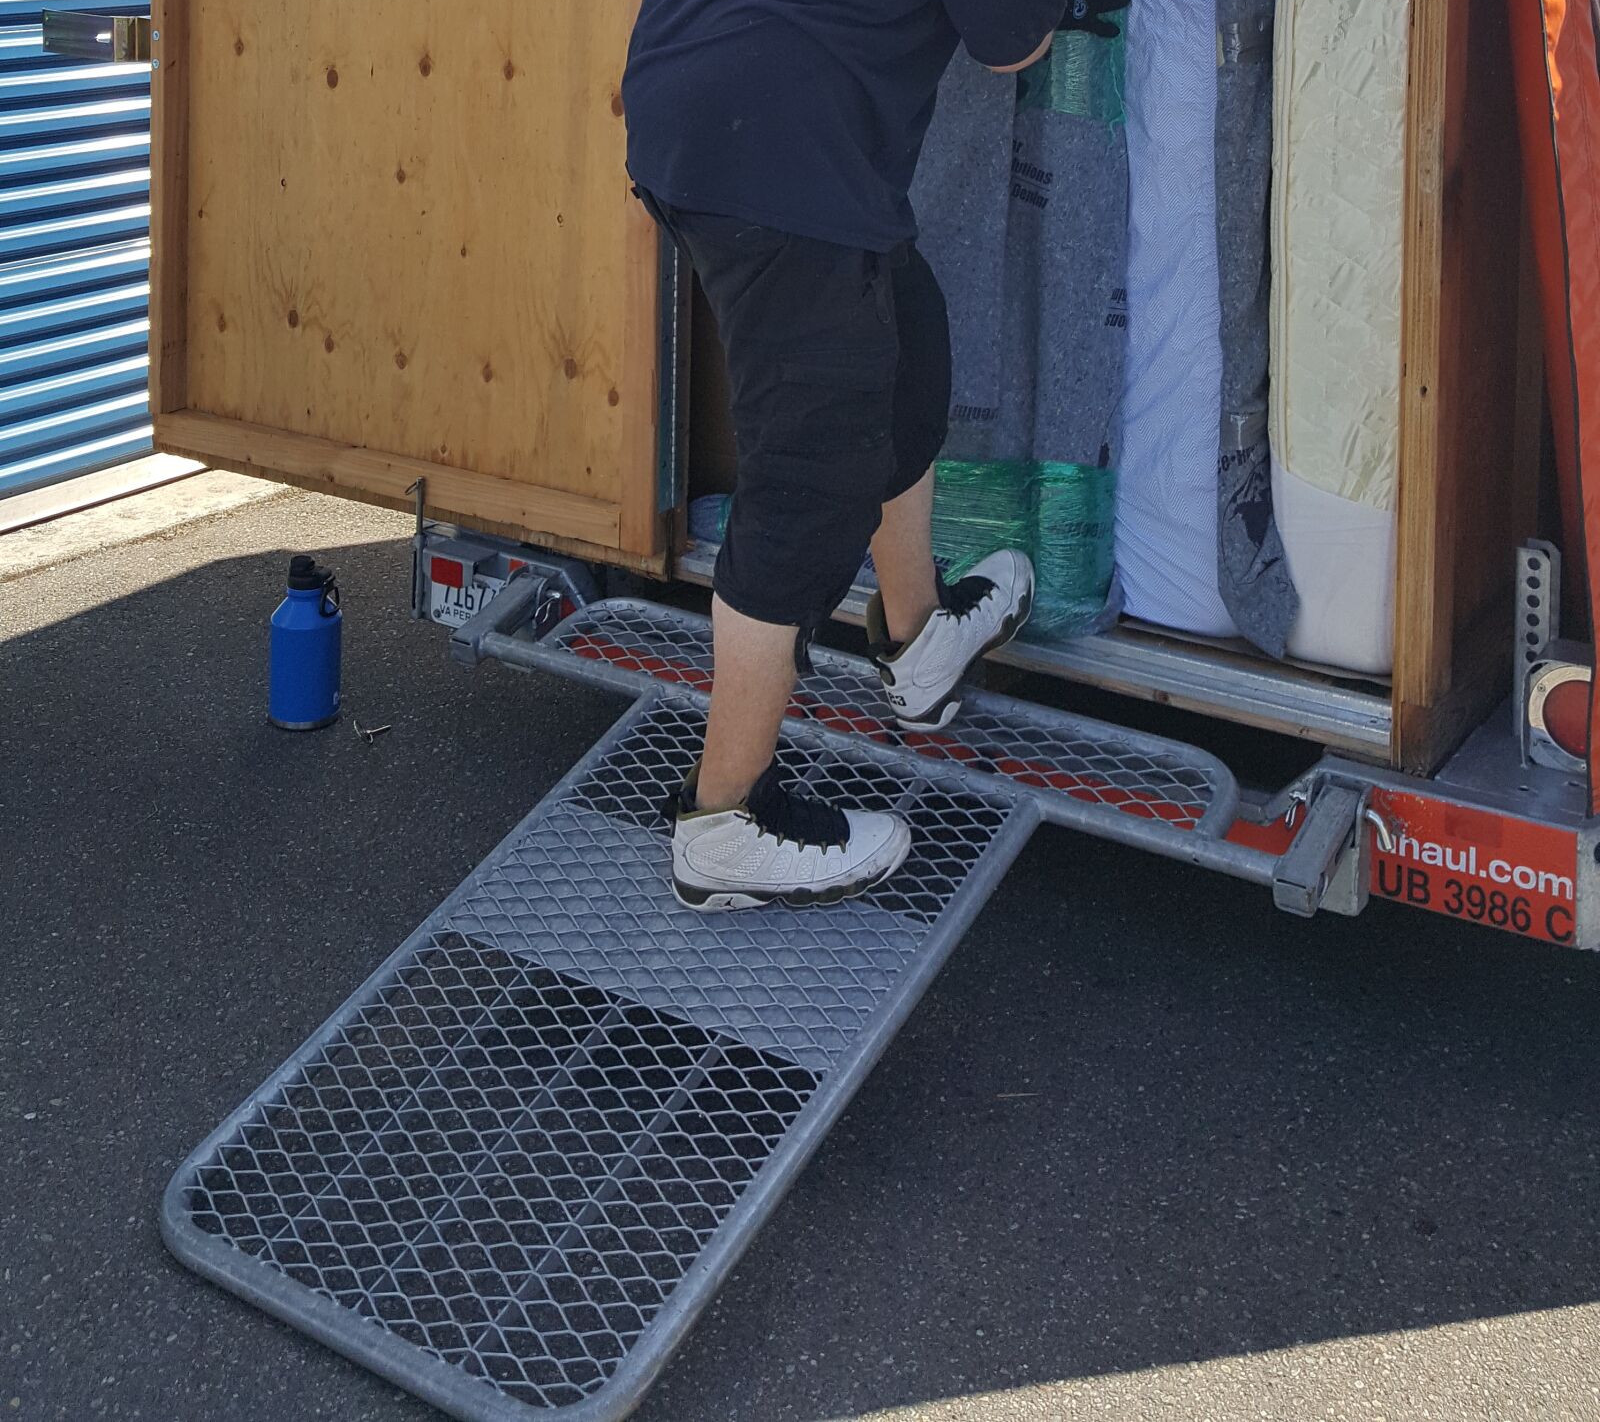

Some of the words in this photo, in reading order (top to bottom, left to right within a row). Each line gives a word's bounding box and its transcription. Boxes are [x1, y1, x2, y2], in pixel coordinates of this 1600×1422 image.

[440, 604, 452, 616] VA
[453, 608, 475, 621] PER
[1378, 860, 1431, 905] UB
[1443, 878, 1532, 933] 3986
[1545, 905, 1573, 942] C
